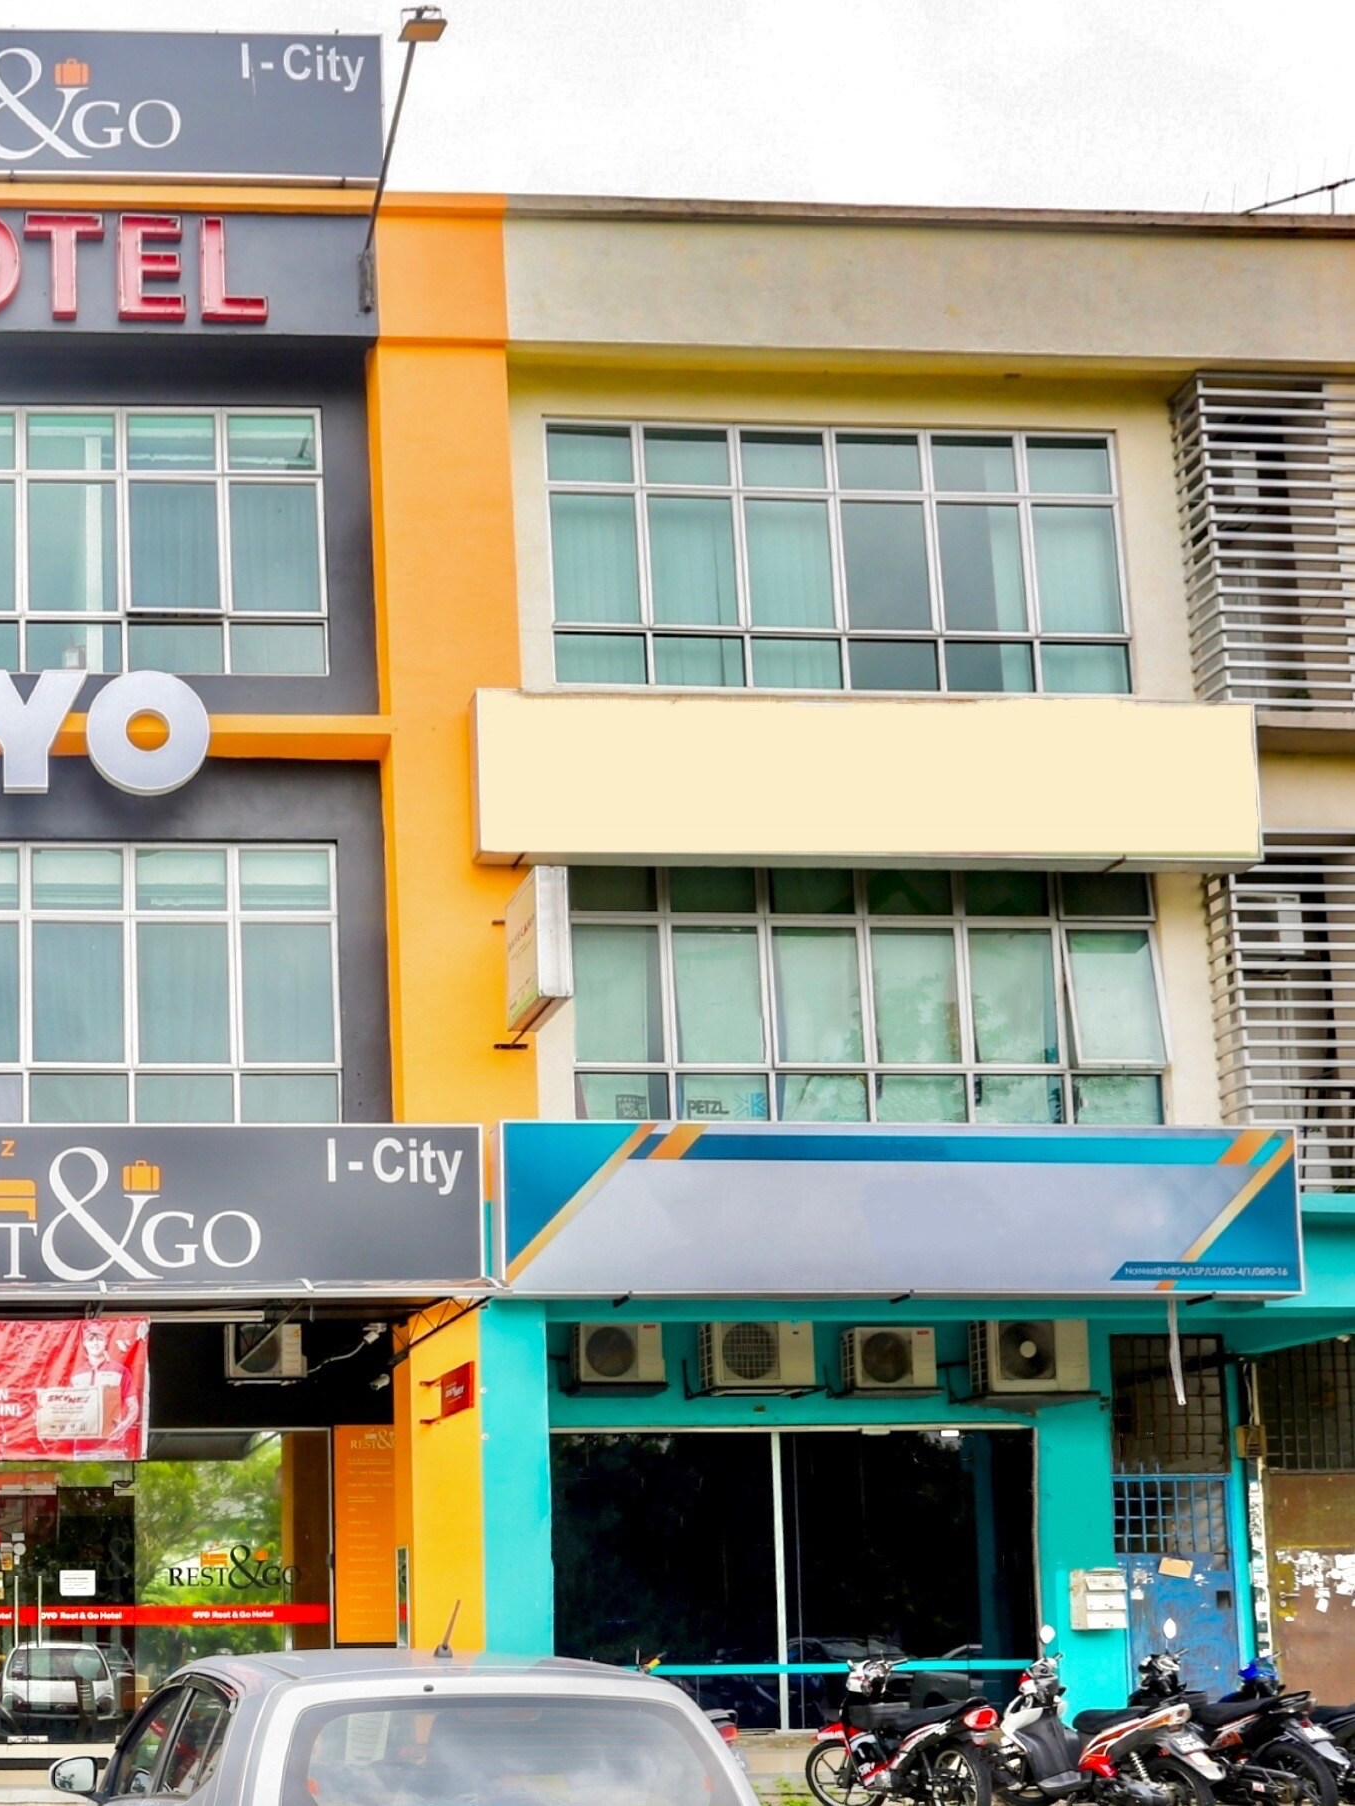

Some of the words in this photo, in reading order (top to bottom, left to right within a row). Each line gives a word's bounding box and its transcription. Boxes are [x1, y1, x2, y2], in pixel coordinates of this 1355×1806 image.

[60, 1612, 80, 1620] Rest
[87, 1612, 99, 1620] Go
[99, 1612, 122, 1620] Hotel
